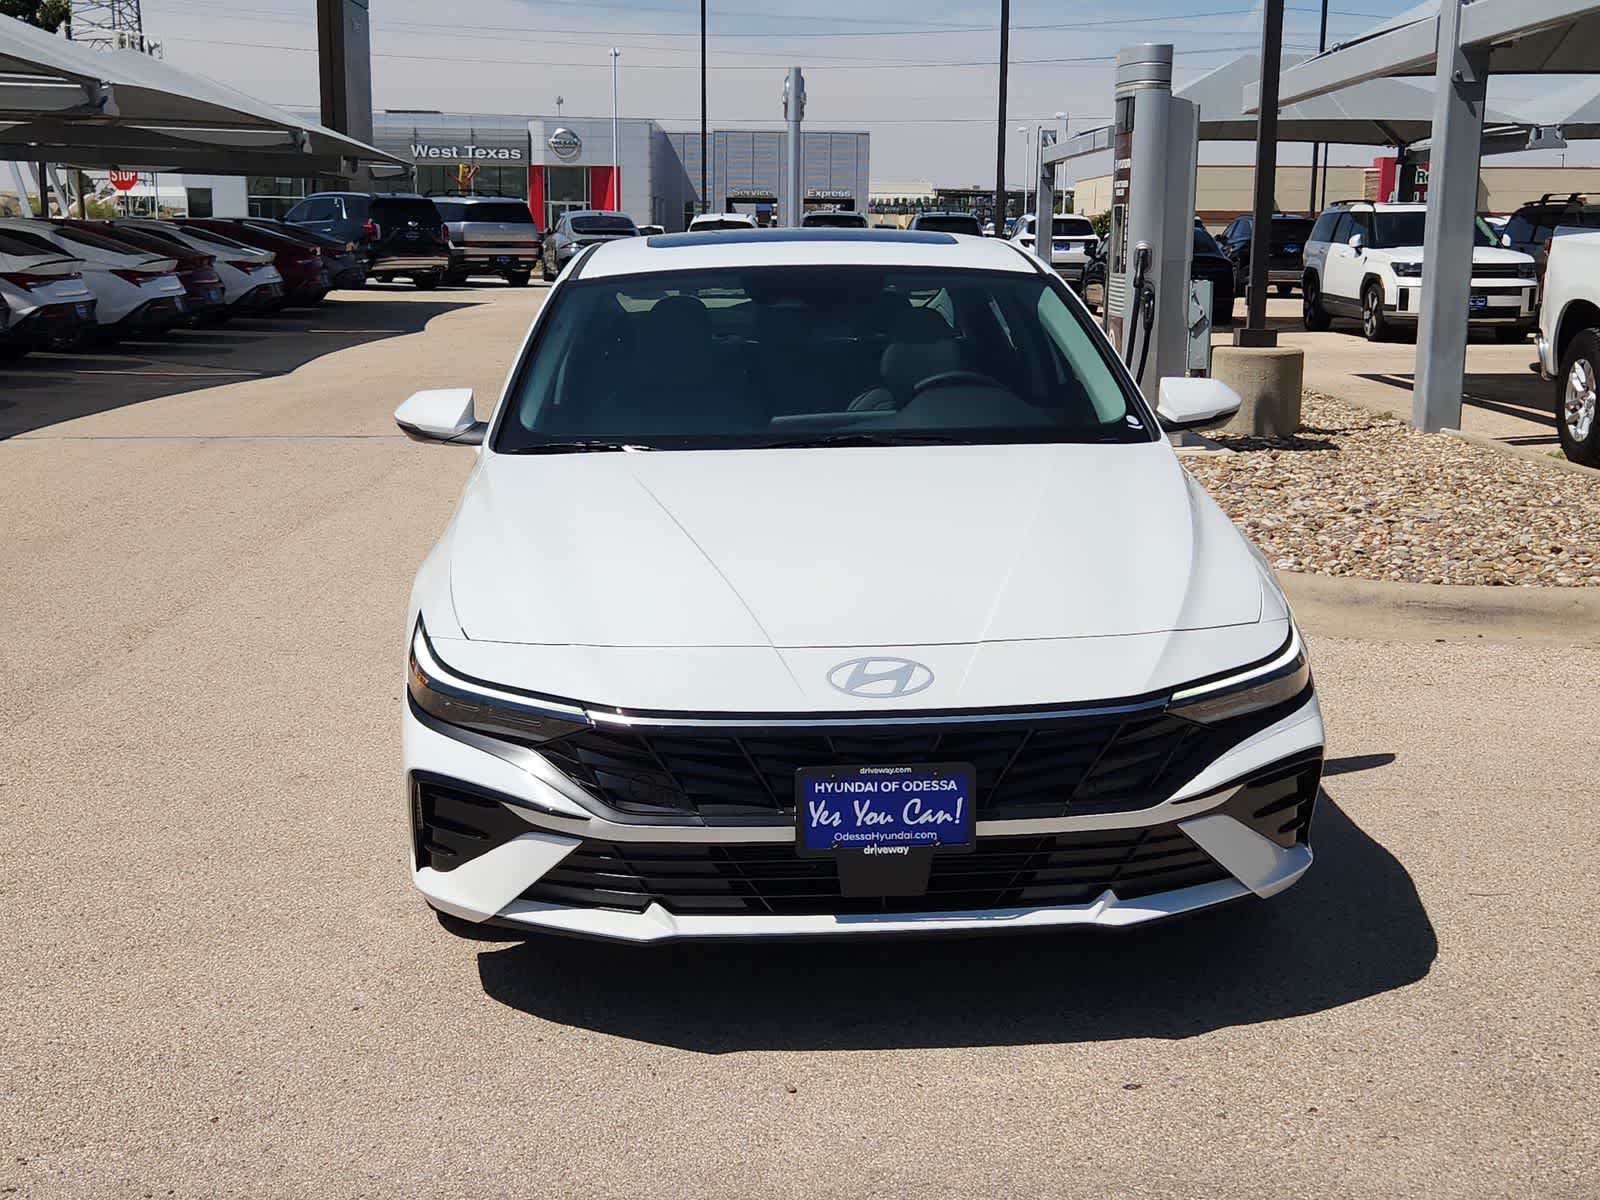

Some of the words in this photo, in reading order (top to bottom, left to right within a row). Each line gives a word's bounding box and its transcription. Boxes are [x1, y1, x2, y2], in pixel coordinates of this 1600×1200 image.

[411, 144, 458, 158] West
[464, 145, 521, 159] Texas
[807, 188, 851, 198] Express
[860, 767, 912, 775] driveway.com
[815, 782, 878, 793] HYUNDAI
[881, 781, 900, 792] OF
[902, 780, 957, 792] ODESSA
[809, 800, 842, 828] Yes
[853, 799, 894, 827] You
[902, 796, 963, 825] Can!
[834, 831, 937, 841] OdessaHyundai.com
[863, 843, 909, 856] driveway
